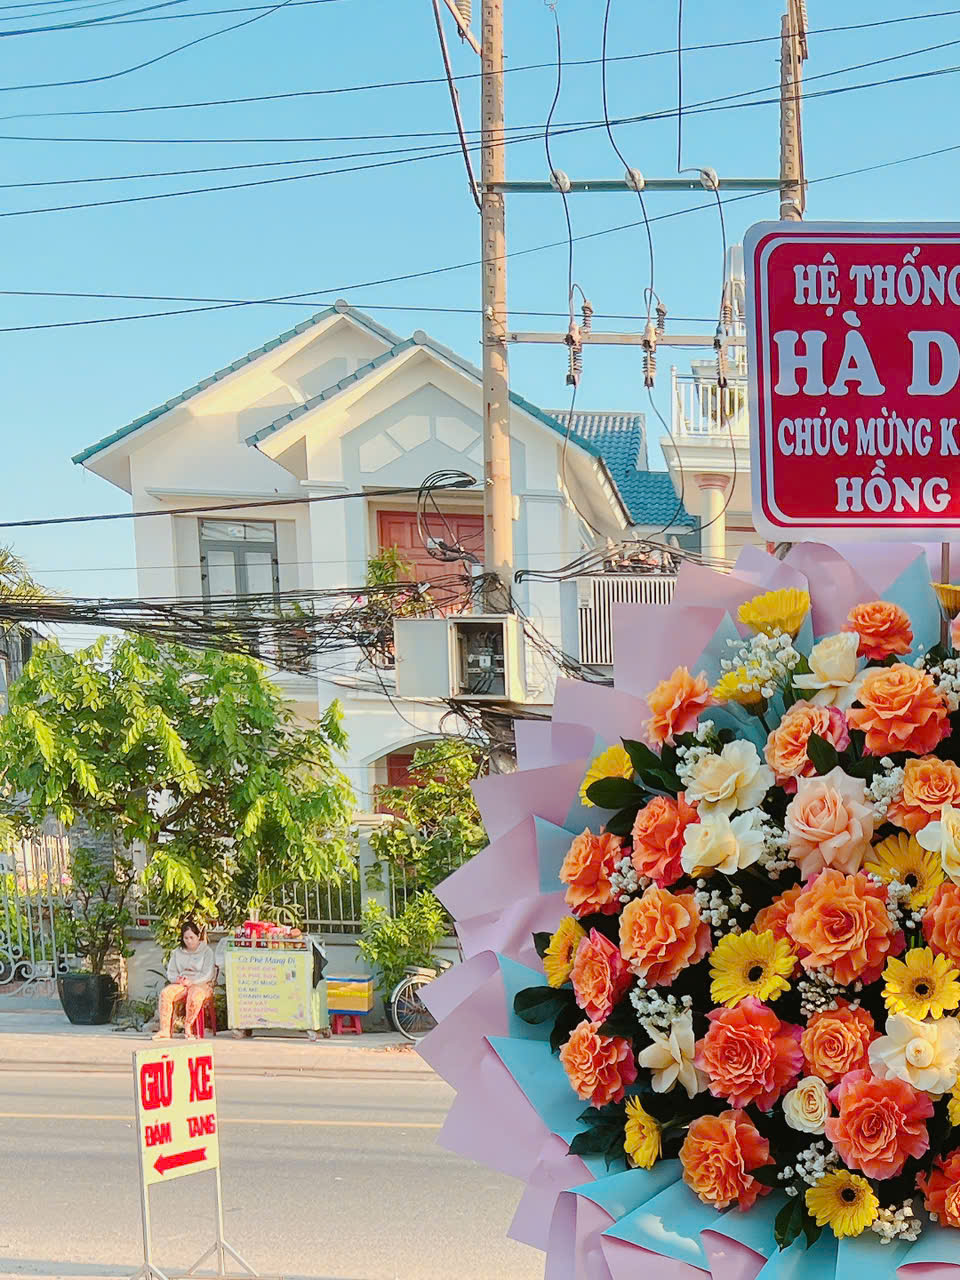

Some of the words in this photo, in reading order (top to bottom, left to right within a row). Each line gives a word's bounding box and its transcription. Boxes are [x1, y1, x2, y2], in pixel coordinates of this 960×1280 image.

[793, 253, 841, 317] HỆ
[773, 310, 886, 397] HÀ
[777, 407, 849, 457] CHÚC
[855, 407, 933, 457] MỪNG
[835, 459, 952, 513] HỒNG
[140, 1054, 174, 1111] GIỮ
[188, 1055, 214, 1103] XE
[144, 1118, 172, 1147] ĐÁM
[186, 1113, 217, 1138] TANG
